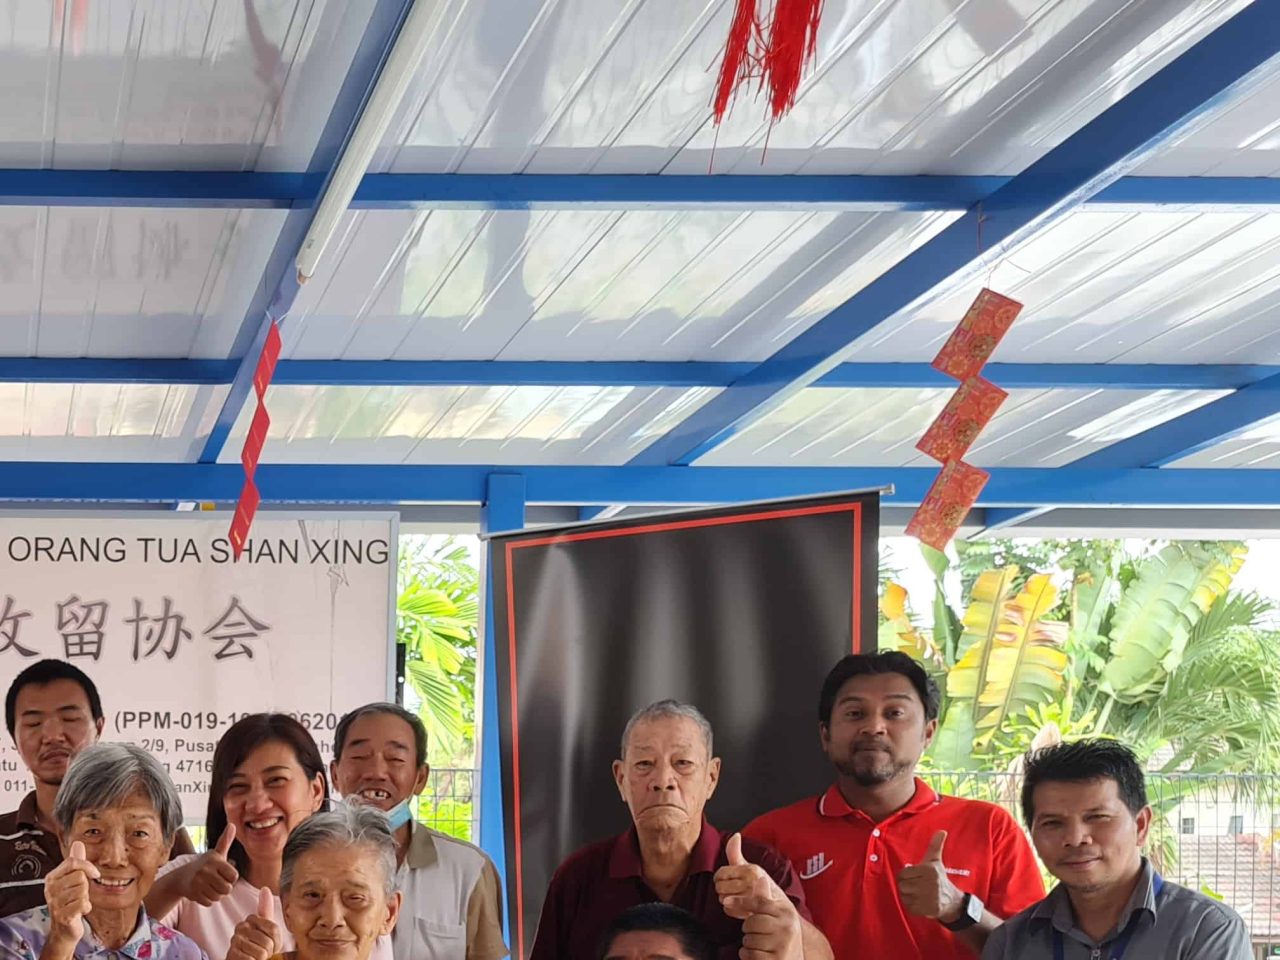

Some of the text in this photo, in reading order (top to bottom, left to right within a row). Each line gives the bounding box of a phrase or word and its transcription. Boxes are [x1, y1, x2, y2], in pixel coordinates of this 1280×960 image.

[8, 536, 126, 562] ORANG
[137, 538, 201, 562] TUA
[210, 538, 298, 564] SHAN
[310, 539, 389, 564] XING
[4, 780, 35, 792] 011-
